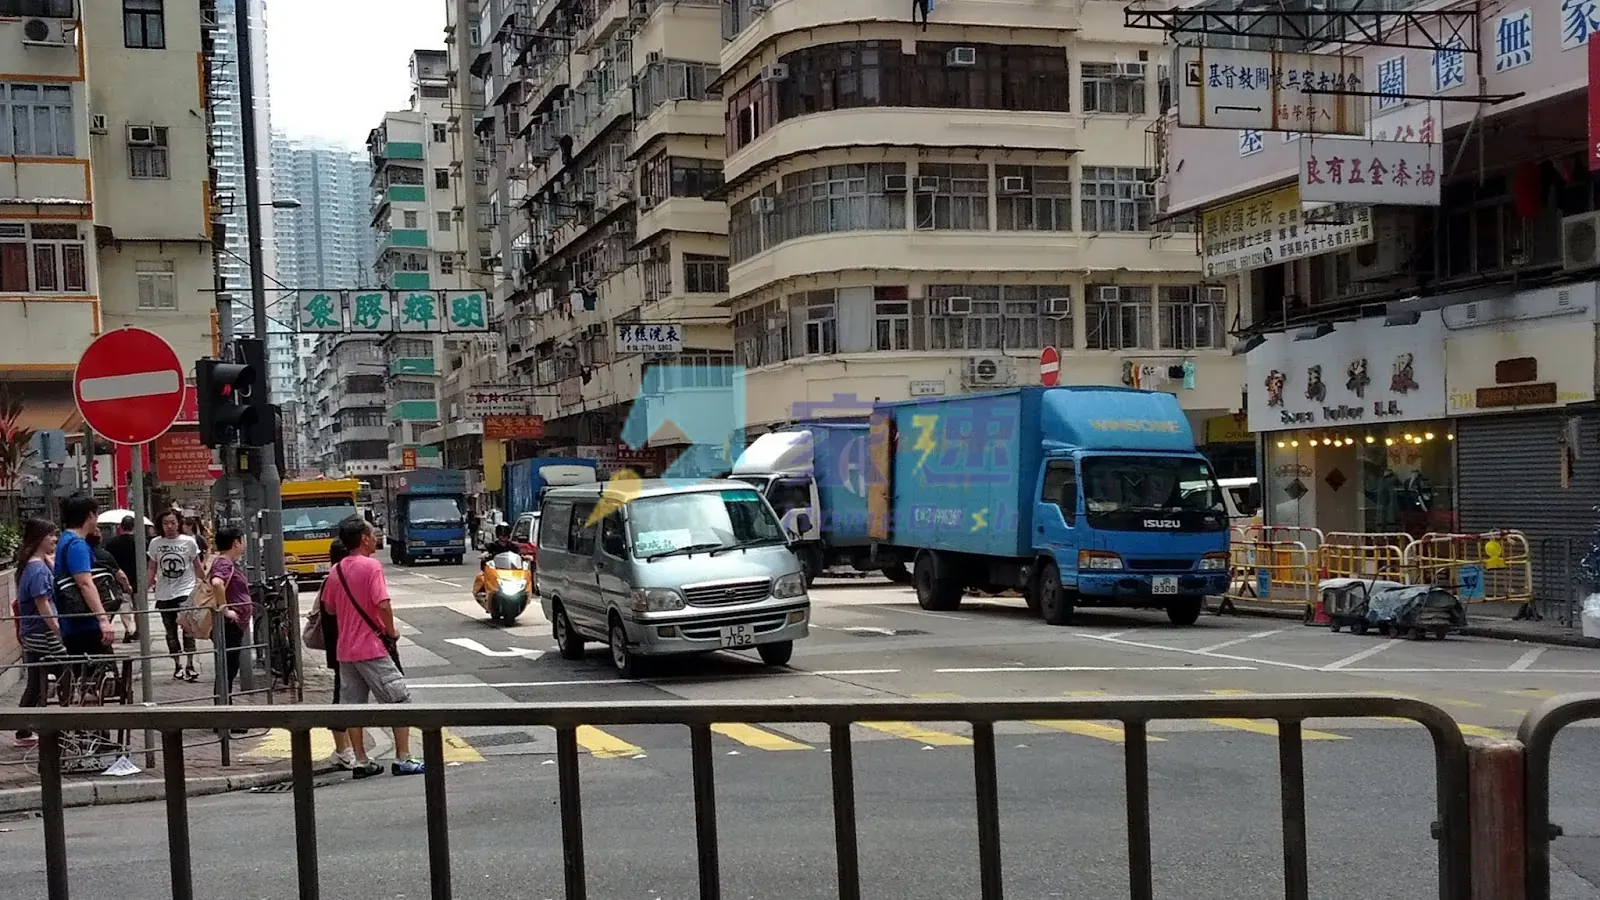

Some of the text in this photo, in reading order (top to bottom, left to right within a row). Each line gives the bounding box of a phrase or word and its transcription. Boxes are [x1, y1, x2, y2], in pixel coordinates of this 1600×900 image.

[1143, 519, 1181, 528] ISUZU
[1159, 577, 1172, 586] JR
[1153, 585, 1176, 593] 9308
[730, 626, 745, 636] LP
[725, 634, 752, 646] 7132
